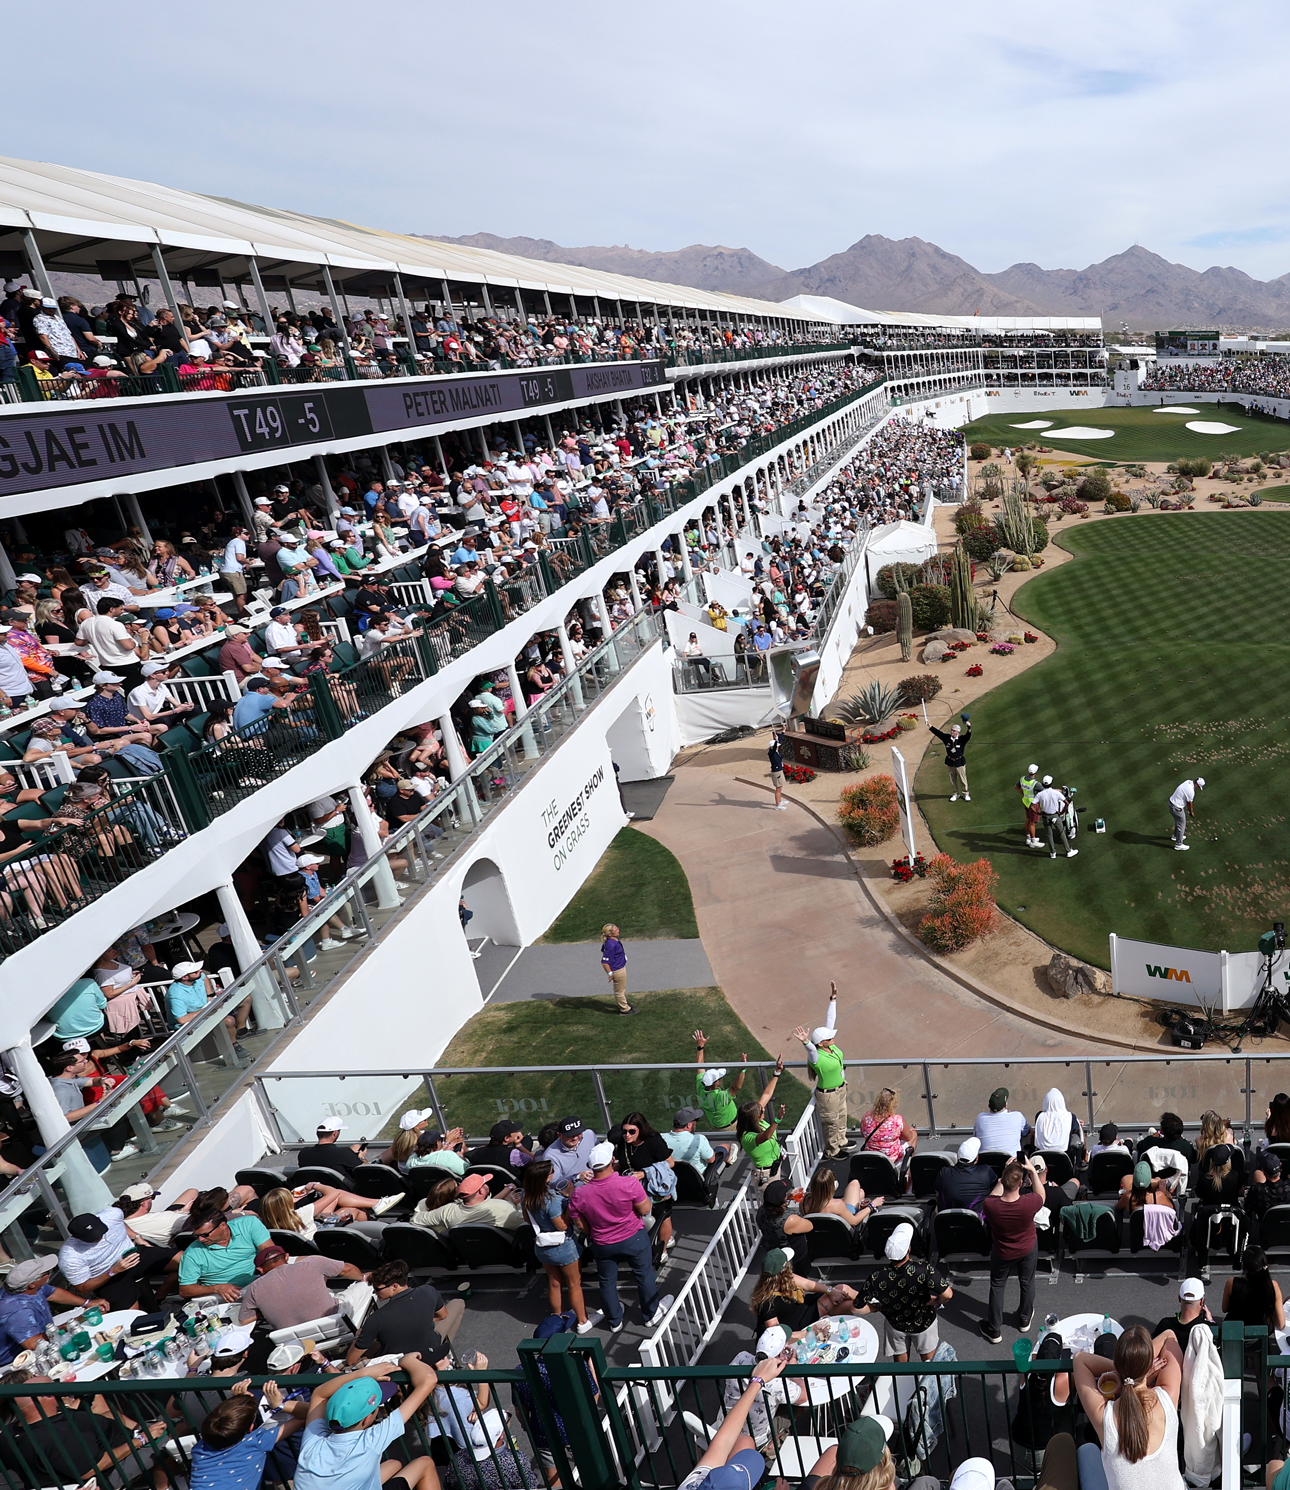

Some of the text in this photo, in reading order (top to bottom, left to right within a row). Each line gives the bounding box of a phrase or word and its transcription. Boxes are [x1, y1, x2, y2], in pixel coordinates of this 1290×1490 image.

[520, 379, 555, 402] T49 -5
[586, 369, 632, 391] AKSHAY BHATIA
[1123, 383, 1131, 391] 16
[402, 383, 502, 419] PETER MALNATI
[233, 402, 321, 442] T49 -5
[98, 420, 147, 464] IM
[541, 799, 559, 827] THE
[547, 765, 605, 849] GREENEST SHOW
[553, 813, 590, 871] ON GRASS
[1145, 964, 1191, 983] WM
